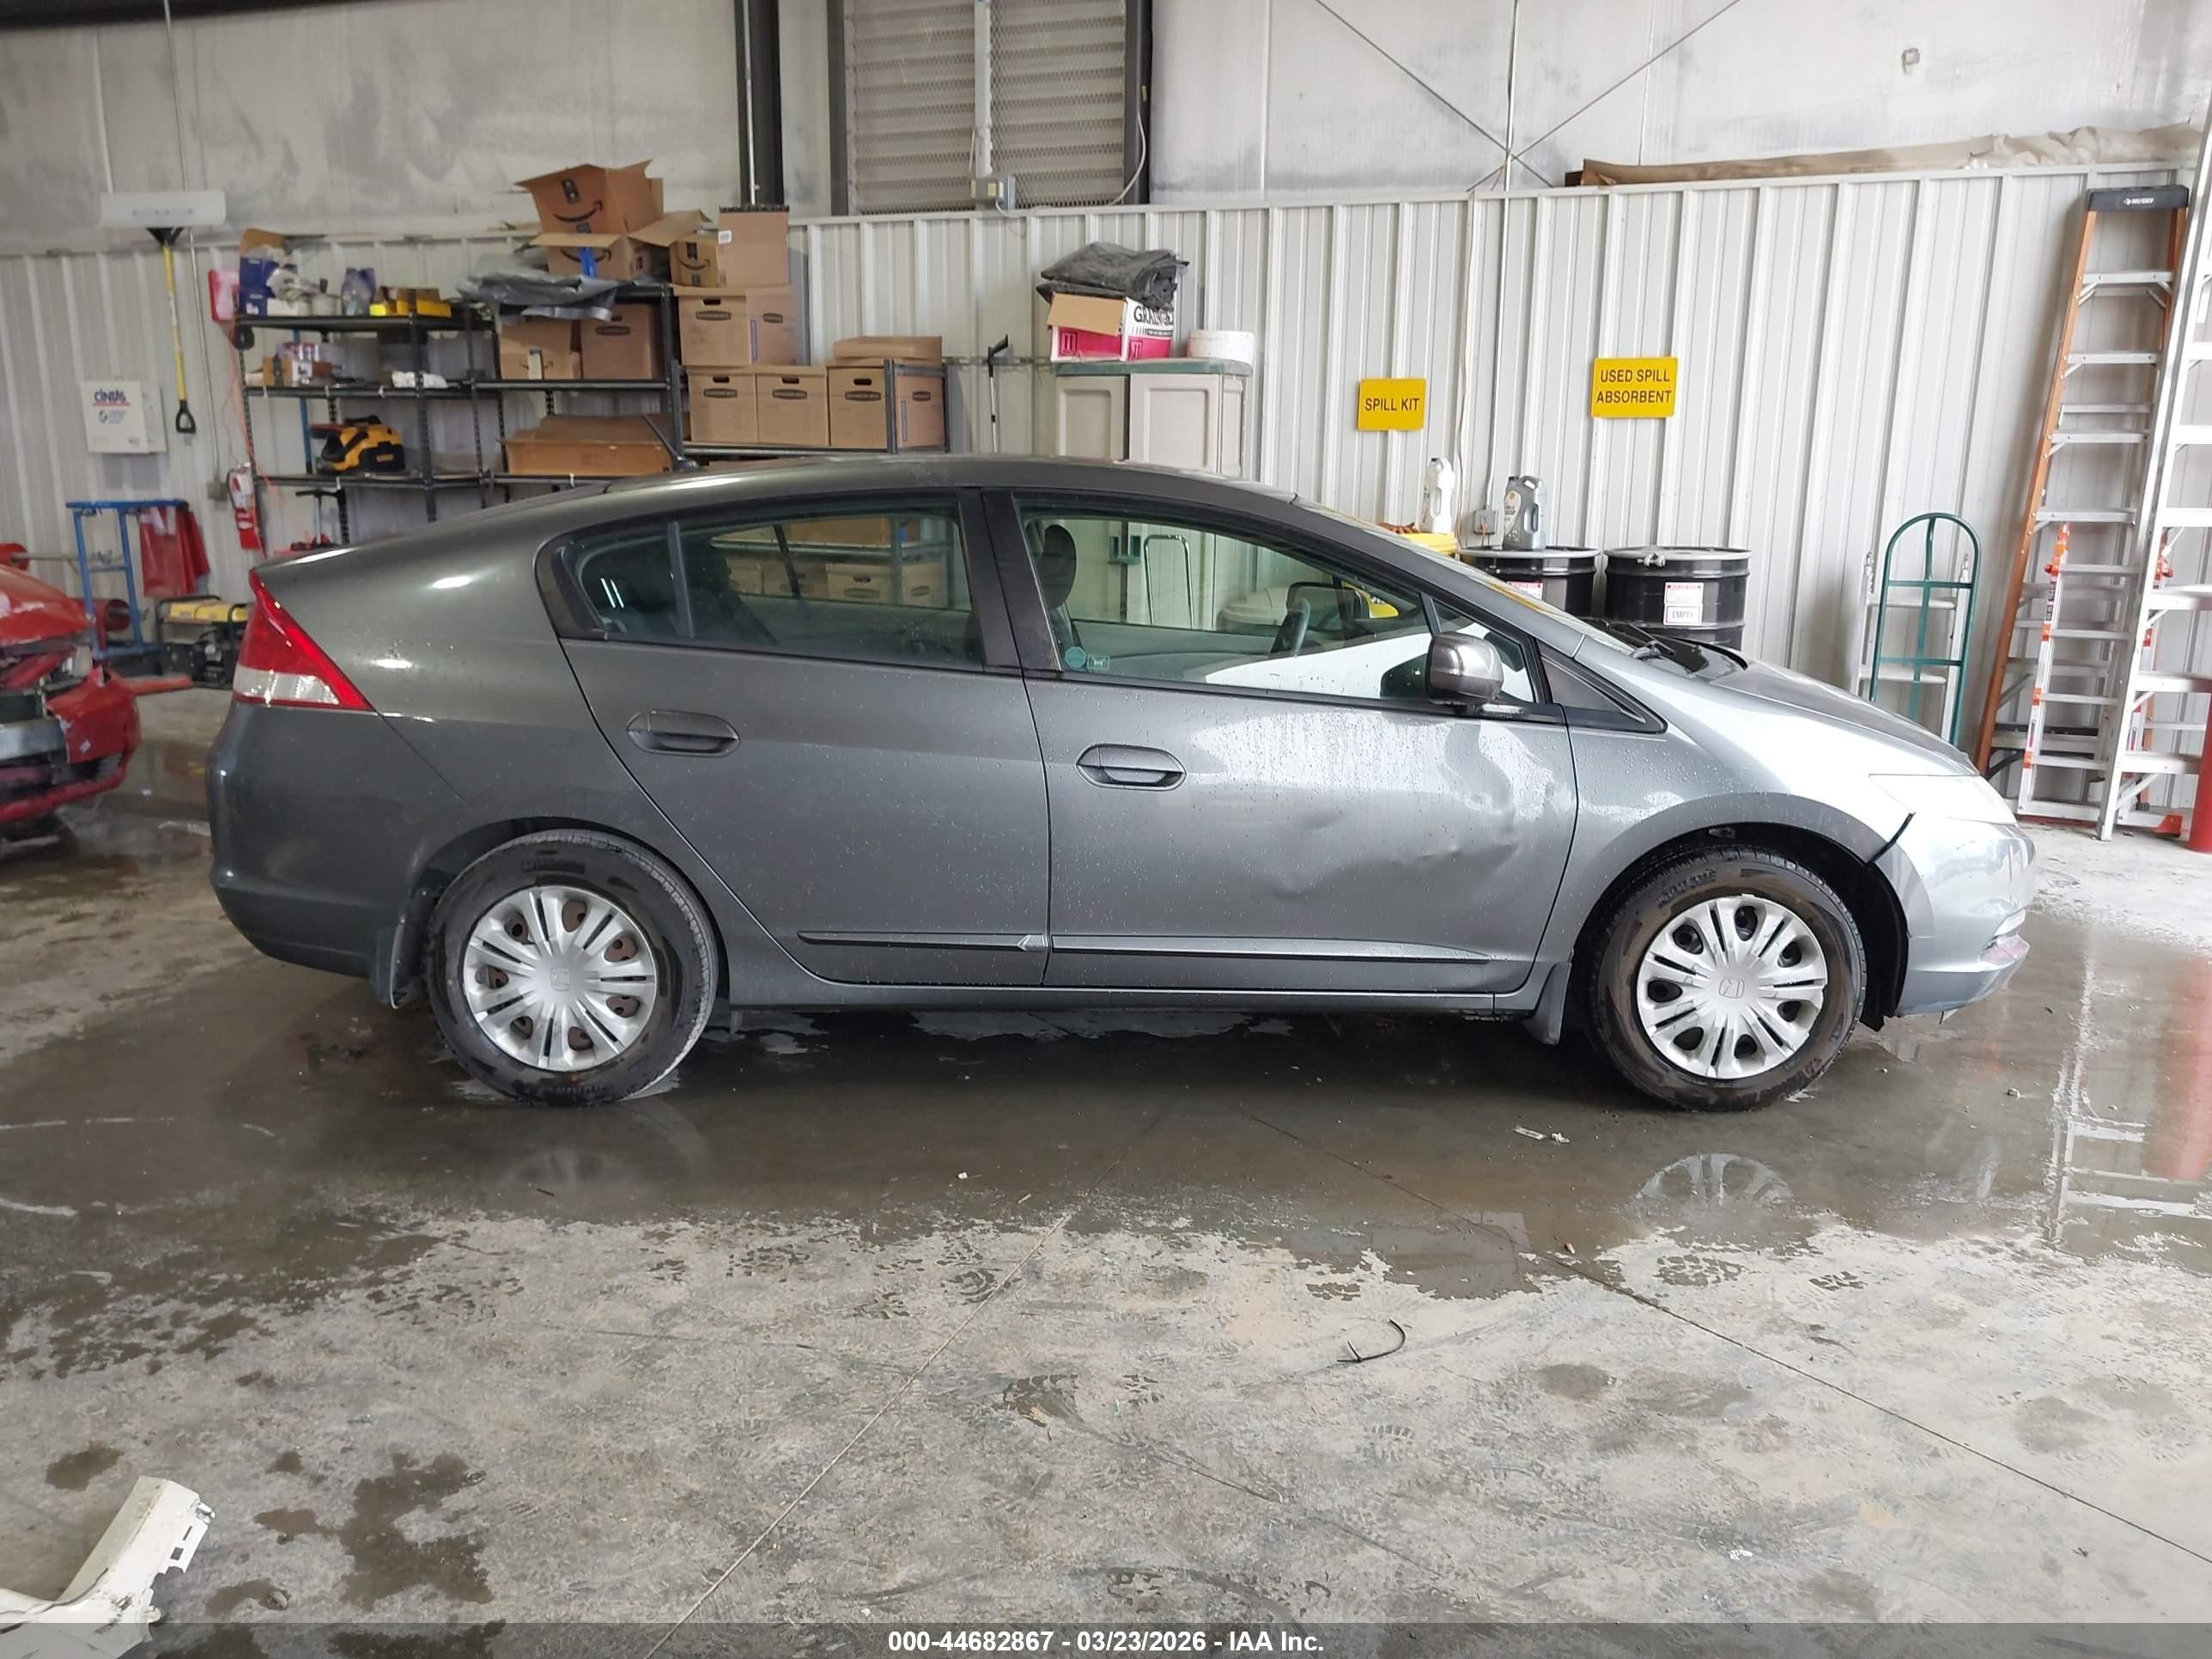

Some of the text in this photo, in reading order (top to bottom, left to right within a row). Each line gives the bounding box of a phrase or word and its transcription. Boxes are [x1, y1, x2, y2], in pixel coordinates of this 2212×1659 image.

[1600, 368, 1670, 383] USED SPILL
[1596, 389, 1672, 404] ABSORBENT
[1365, 398, 1419, 411] SPILL KIT
[1672, 611, 1693, 619] EMPTY
